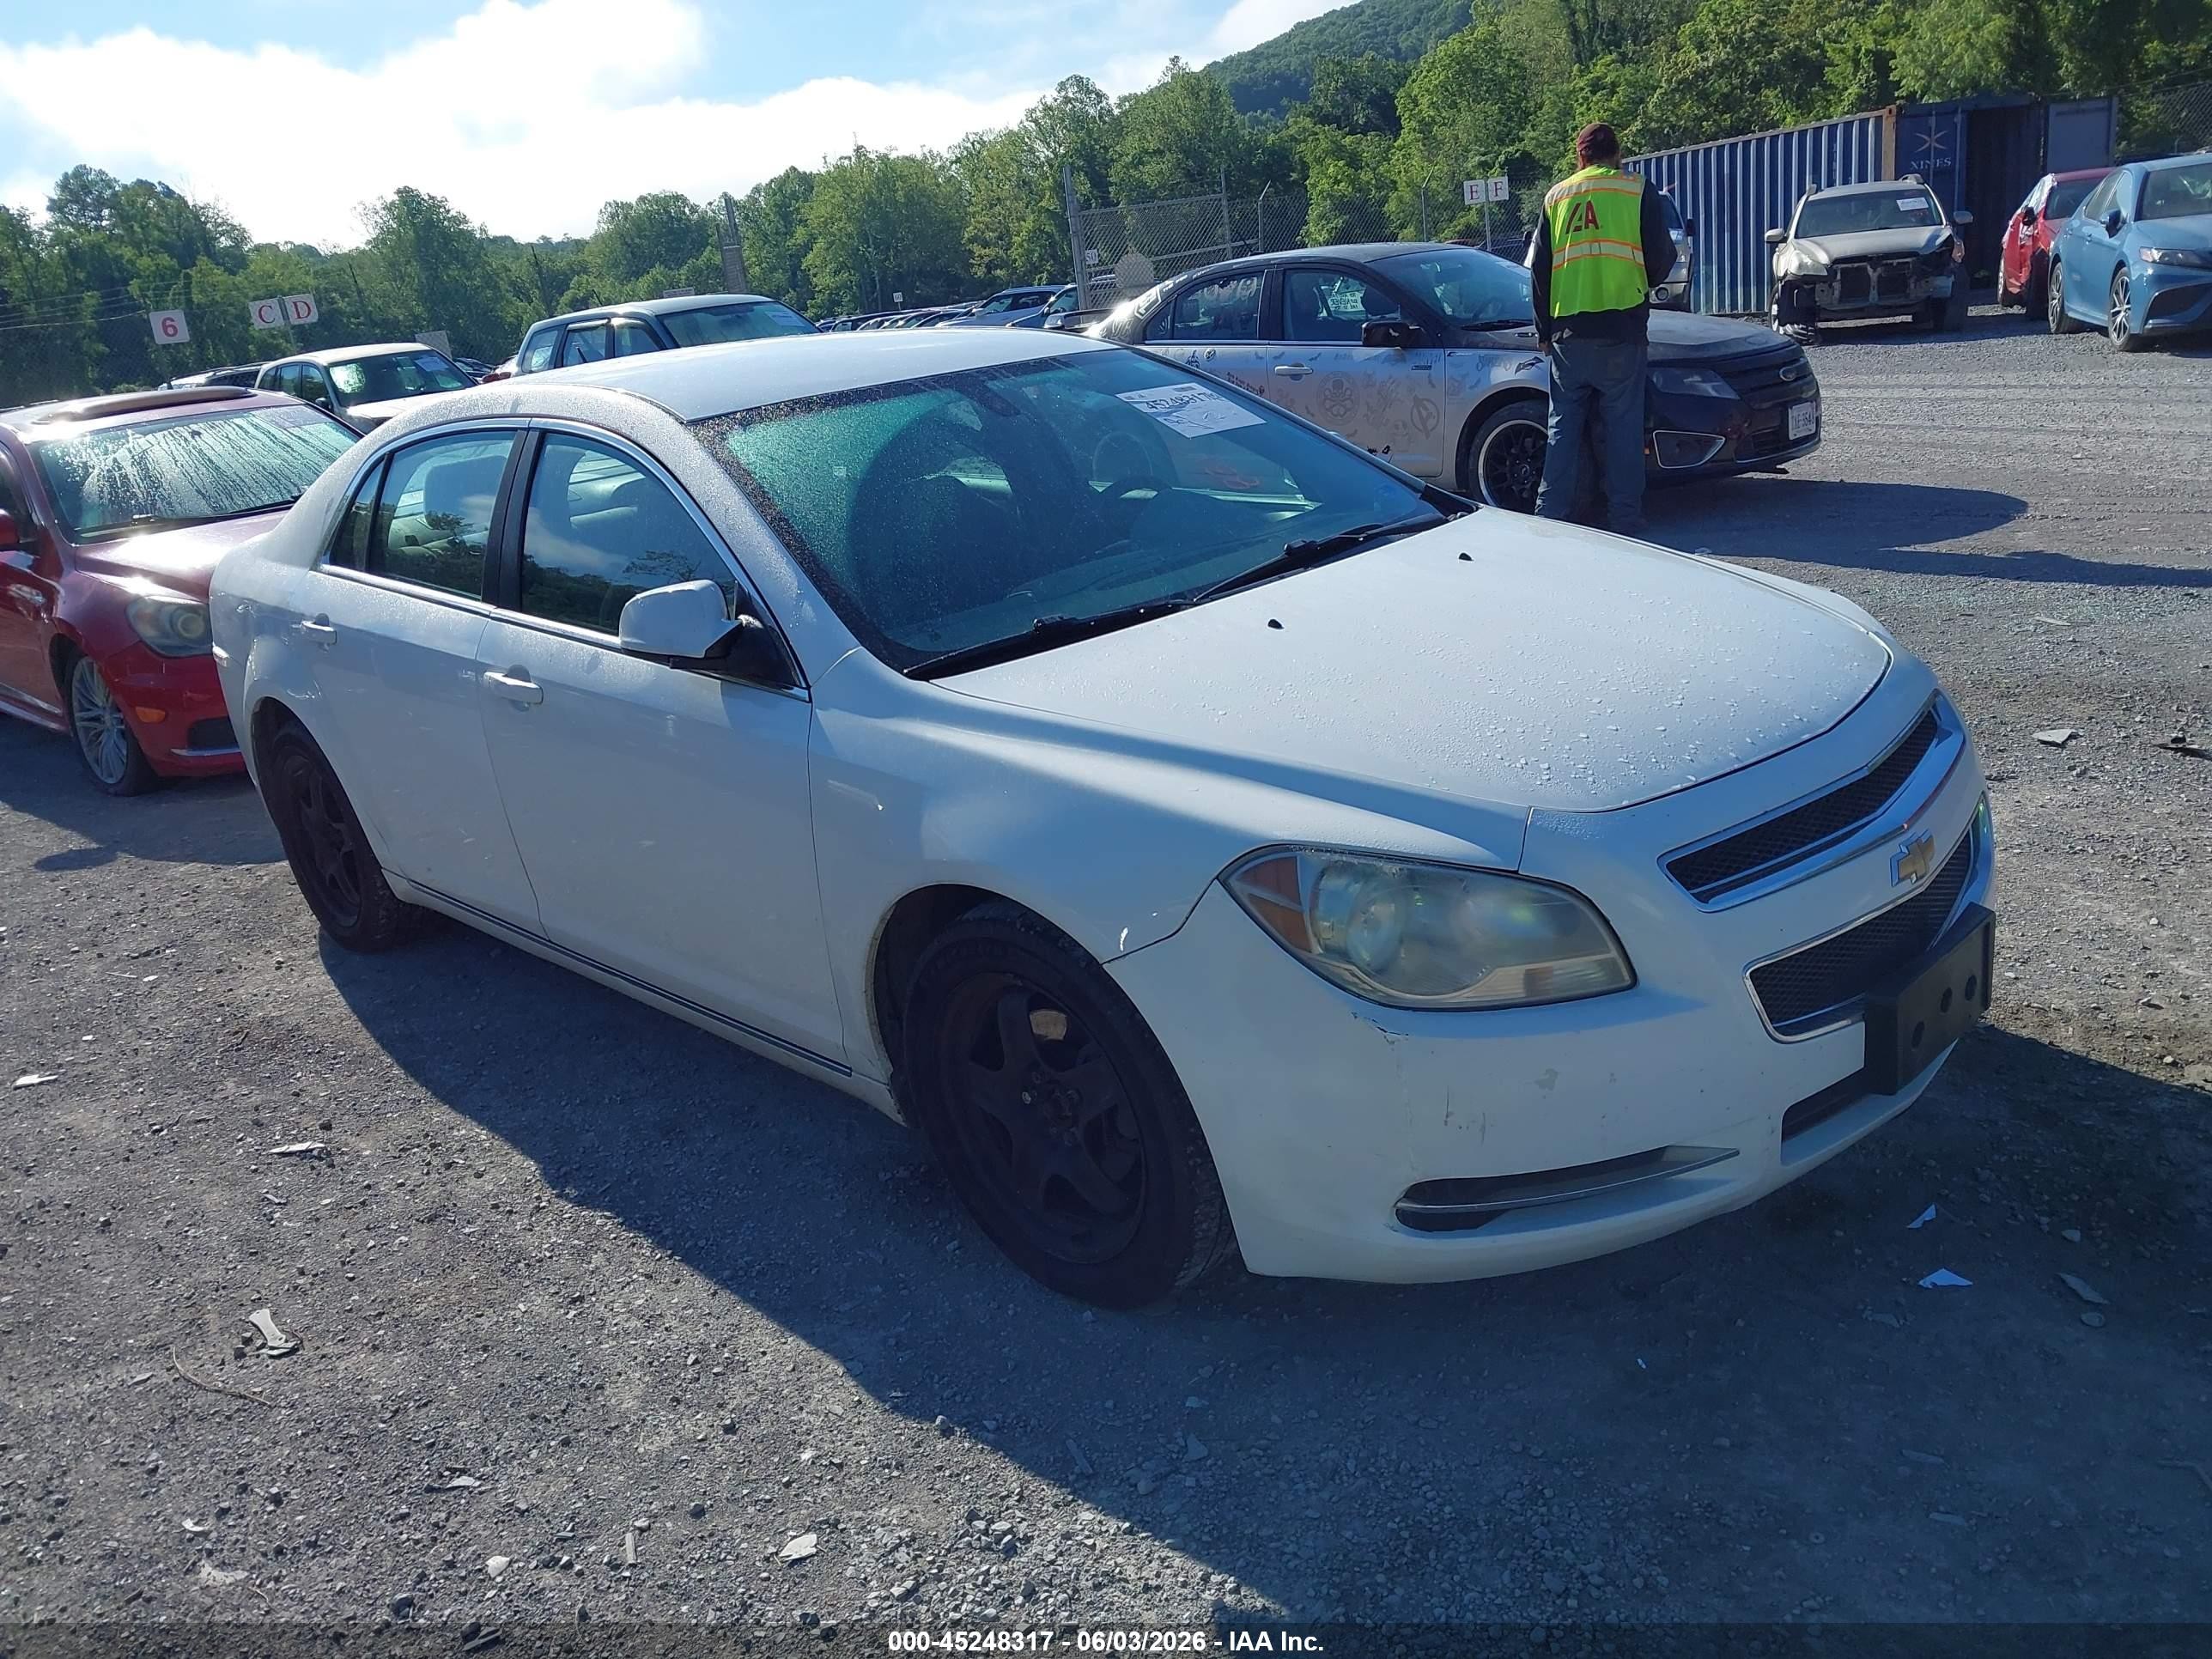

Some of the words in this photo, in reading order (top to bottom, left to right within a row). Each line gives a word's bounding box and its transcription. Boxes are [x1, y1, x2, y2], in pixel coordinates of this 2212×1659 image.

[1469, 184, 1480, 200] E
[1494, 181, 1504, 198] F
[258, 305, 276, 324] C
[292, 301, 312, 319] D
[161, 316, 179, 337] 6
